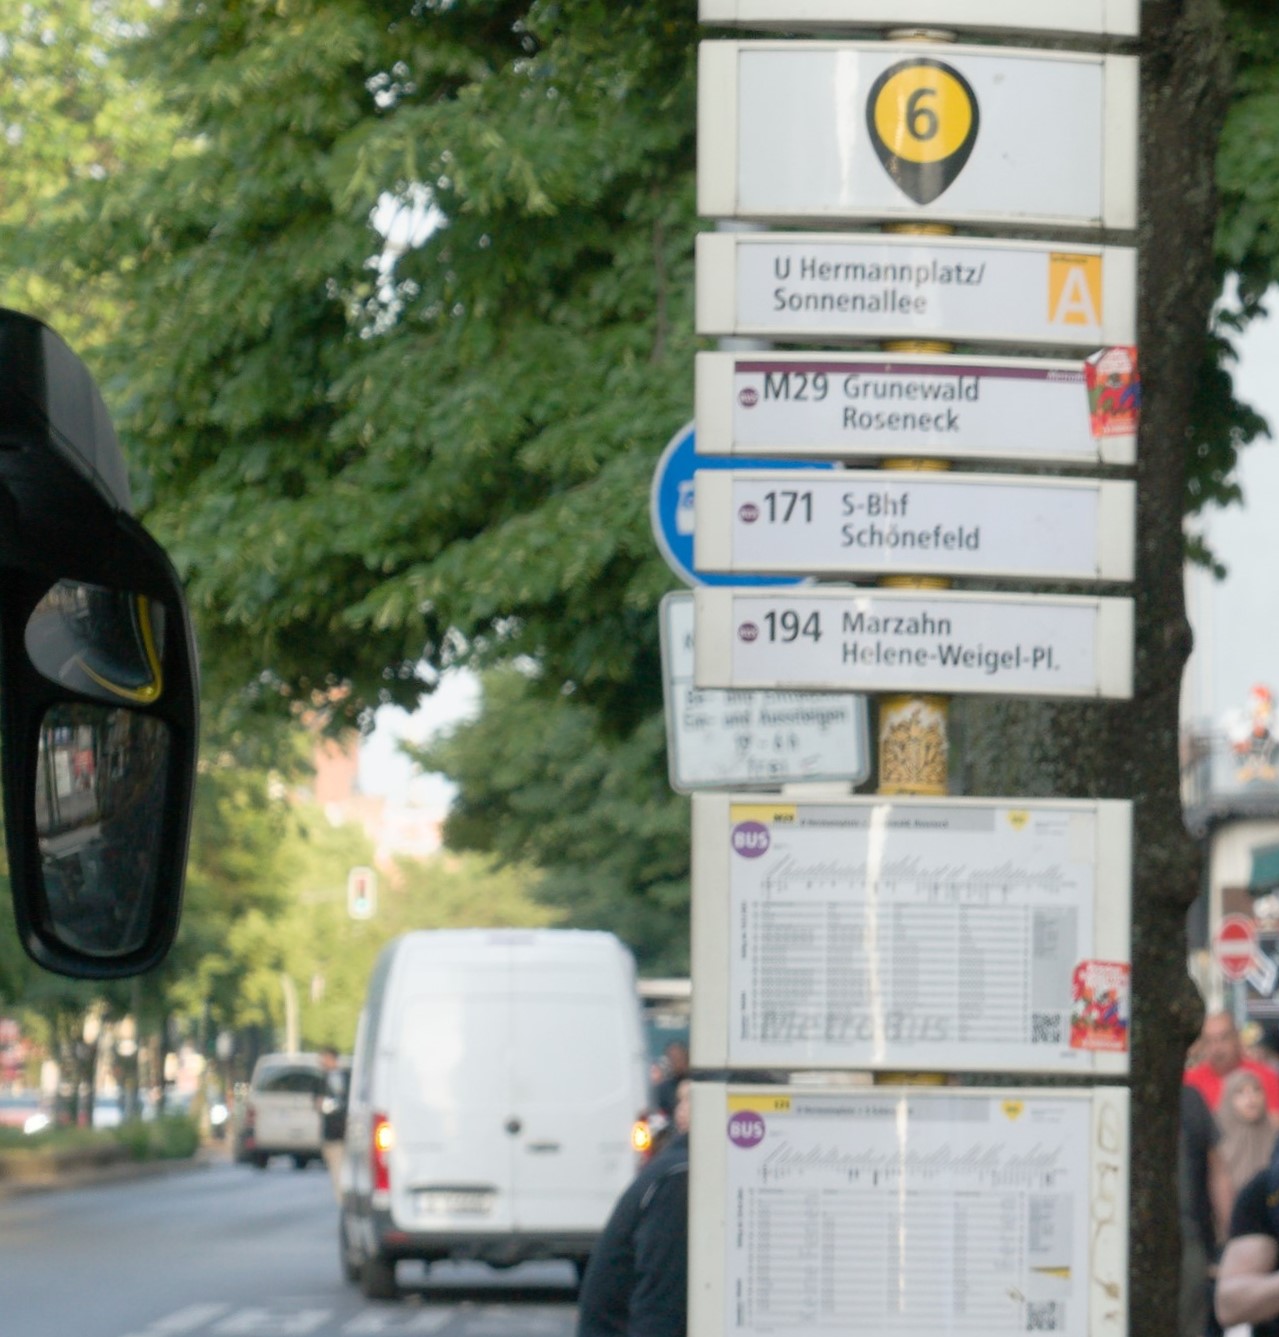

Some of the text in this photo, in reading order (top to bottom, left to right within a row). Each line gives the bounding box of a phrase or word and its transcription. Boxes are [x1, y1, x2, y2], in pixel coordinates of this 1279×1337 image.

[905, 87, 939, 141] 6
[774, 256, 986, 288] U Hermannplatz/
[774, 287, 927, 314] Sonnenallee
[1055, 267, 1101, 326] A
[763, 372, 829, 401] M29
[843, 375, 980, 400] Grunewald
[843, 406, 960, 432] Roseneck
[765, 491, 814, 523] 171
[842, 492, 909, 516] S-Bhf
[841, 523, 981, 550] Schönefeld
[764, 610, 822, 643] 194
[842, 612, 952, 635] Marzahn
[842, 643, 1060, 674] Helene-Weigel-Pl.
[733, 830, 768, 850] BUS
[730, 1120, 764, 1140] BUS
